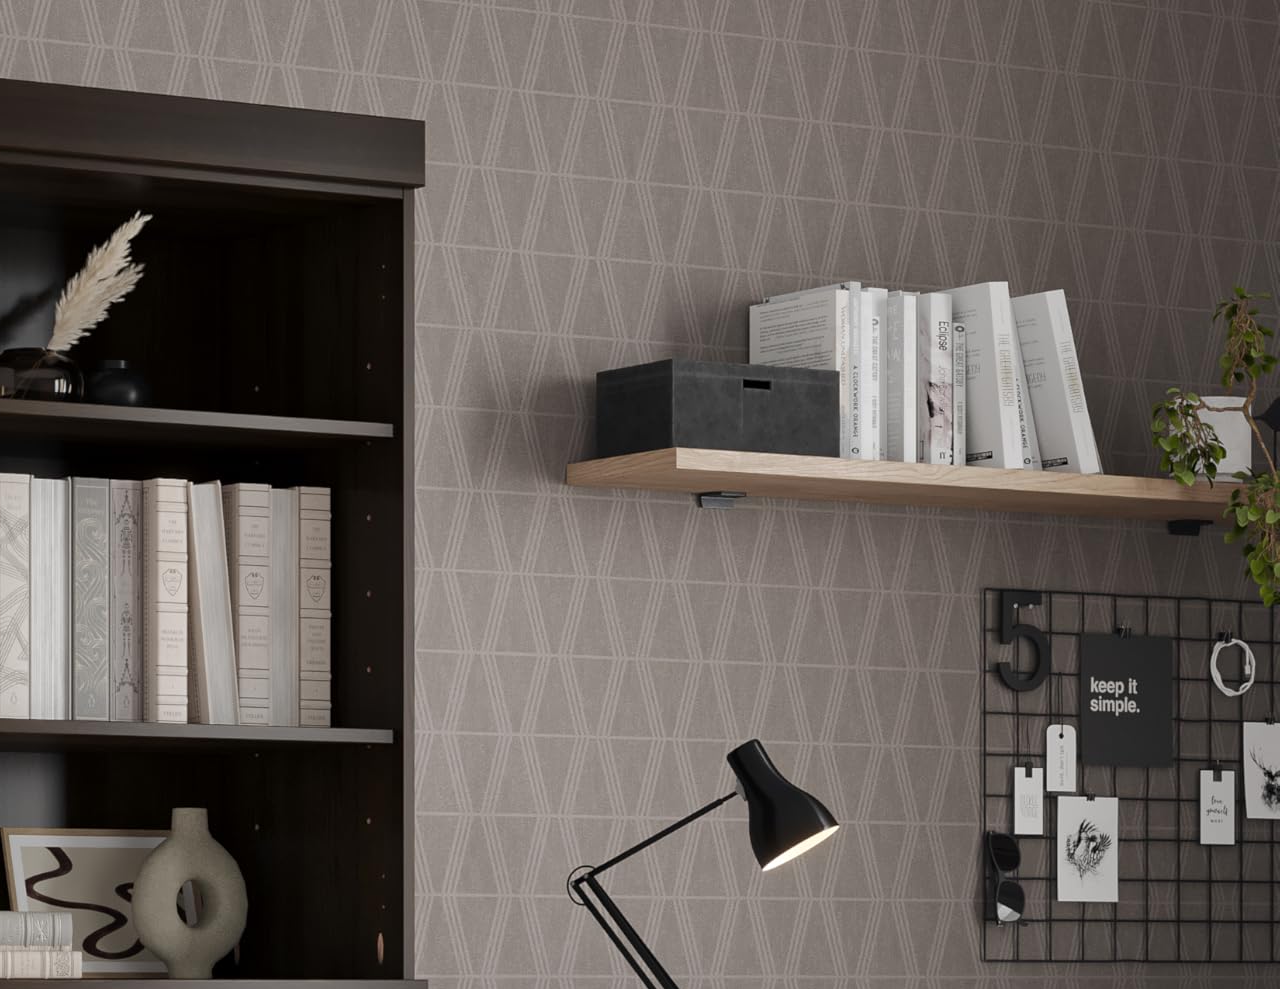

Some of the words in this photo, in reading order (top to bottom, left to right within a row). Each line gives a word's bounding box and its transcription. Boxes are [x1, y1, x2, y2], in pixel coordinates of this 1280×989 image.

[936, 320, 950, 351] Eclipse
[955, 342, 964, 351] THE
[955, 352, 964, 367] GREAT
[999, 349, 1012, 376] GREAT
[1001, 376, 1014, 407] GATSBY
[1090, 676, 1125, 698] keep
[1128, 677, 1138, 695] it
[1090, 695, 1140, 717] simple.
